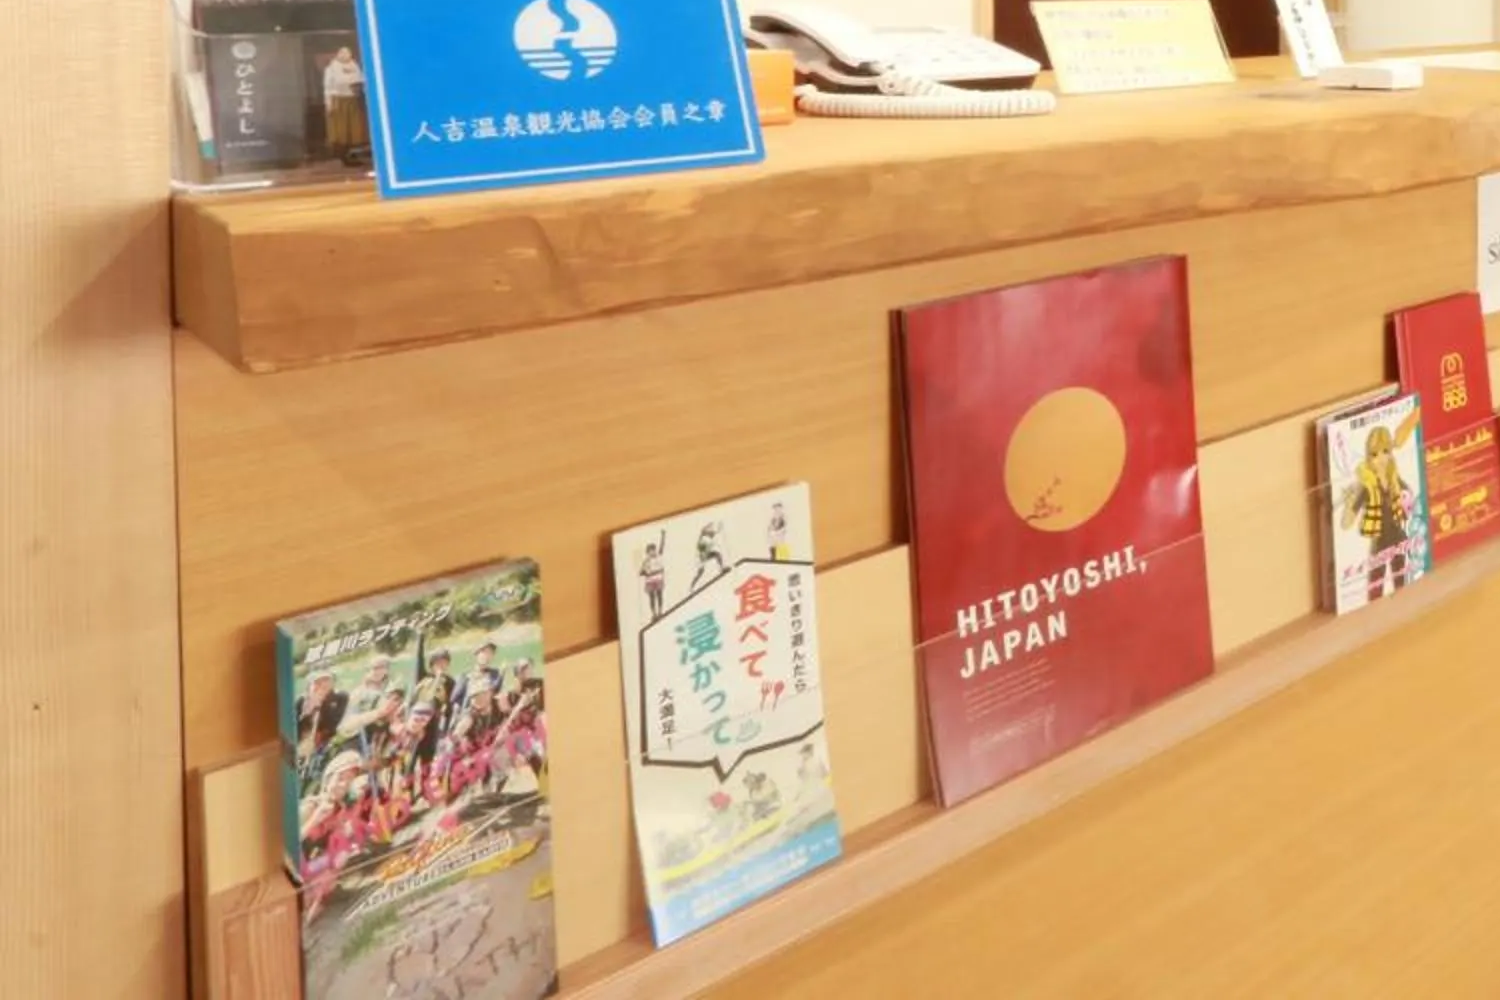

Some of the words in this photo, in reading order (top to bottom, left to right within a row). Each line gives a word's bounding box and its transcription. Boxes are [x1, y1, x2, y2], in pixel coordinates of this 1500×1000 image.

[411, 98, 727, 144] 人吉温泉観光協会会員之章
[734, 573, 777, 678] 食べて
[956, 544, 1148, 639] HITOYOSHI,
[675, 610, 731, 745] 浸かって
[960, 610, 1068, 680] JAPAN
